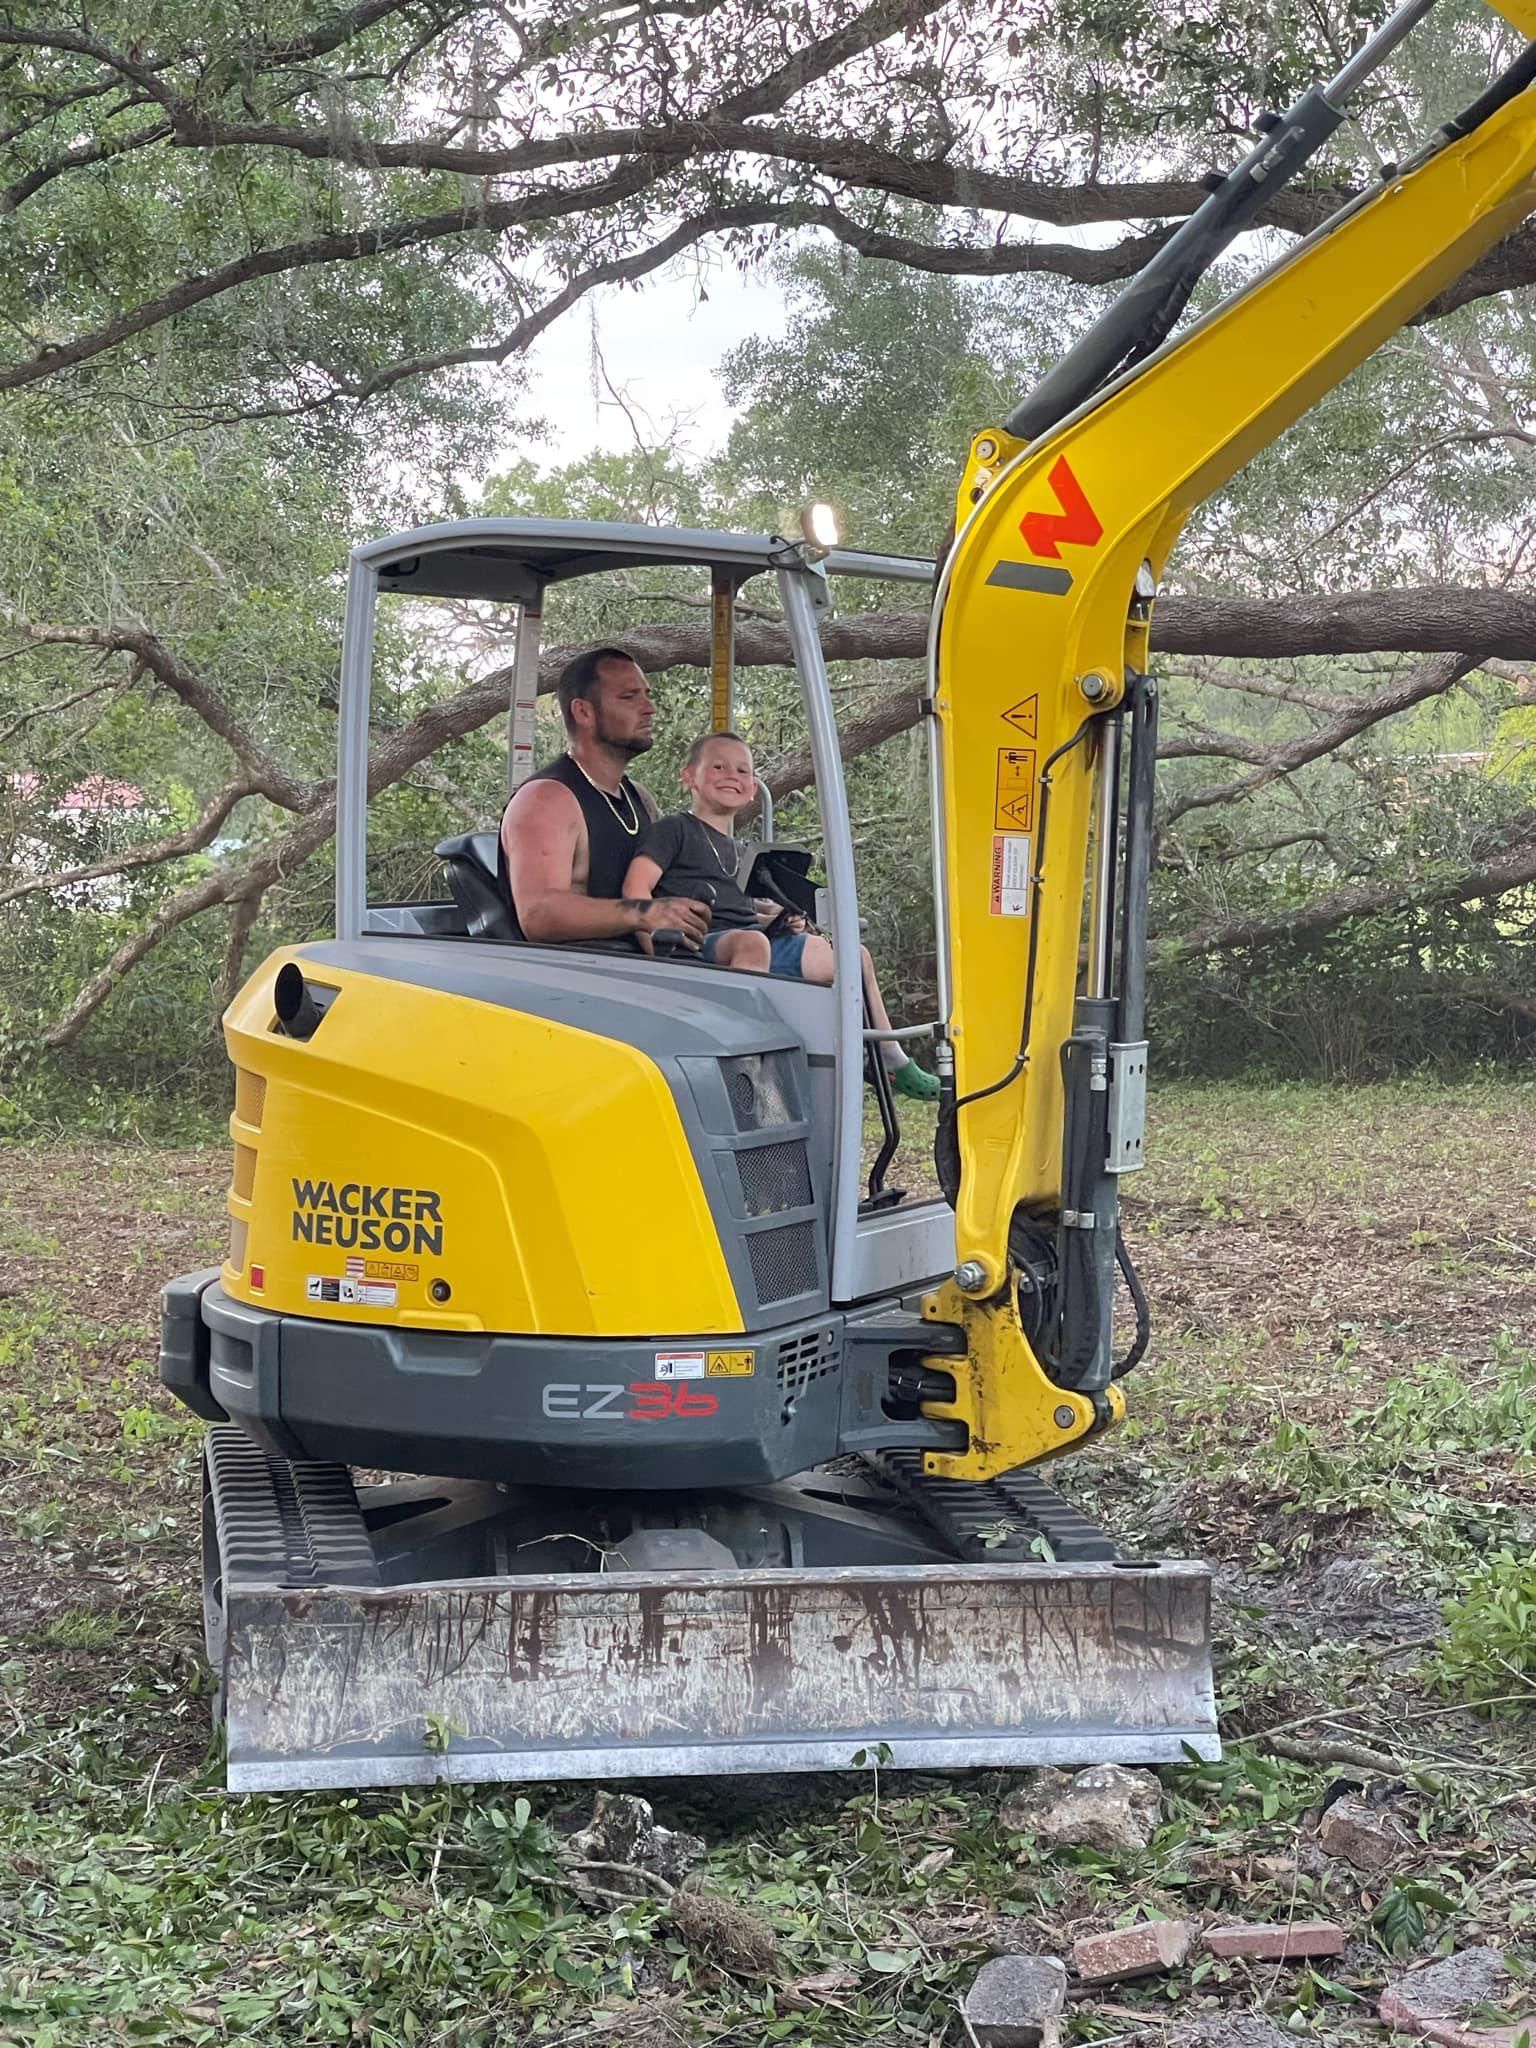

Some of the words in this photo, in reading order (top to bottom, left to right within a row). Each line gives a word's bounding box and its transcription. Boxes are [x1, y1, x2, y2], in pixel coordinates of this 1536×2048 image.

[992, 847, 1001, 892] WARNING
[292, 1178, 443, 1222] WACKER
[292, 1211, 443, 1256] NEUSON
[542, 1382, 719, 1420] EZ36
